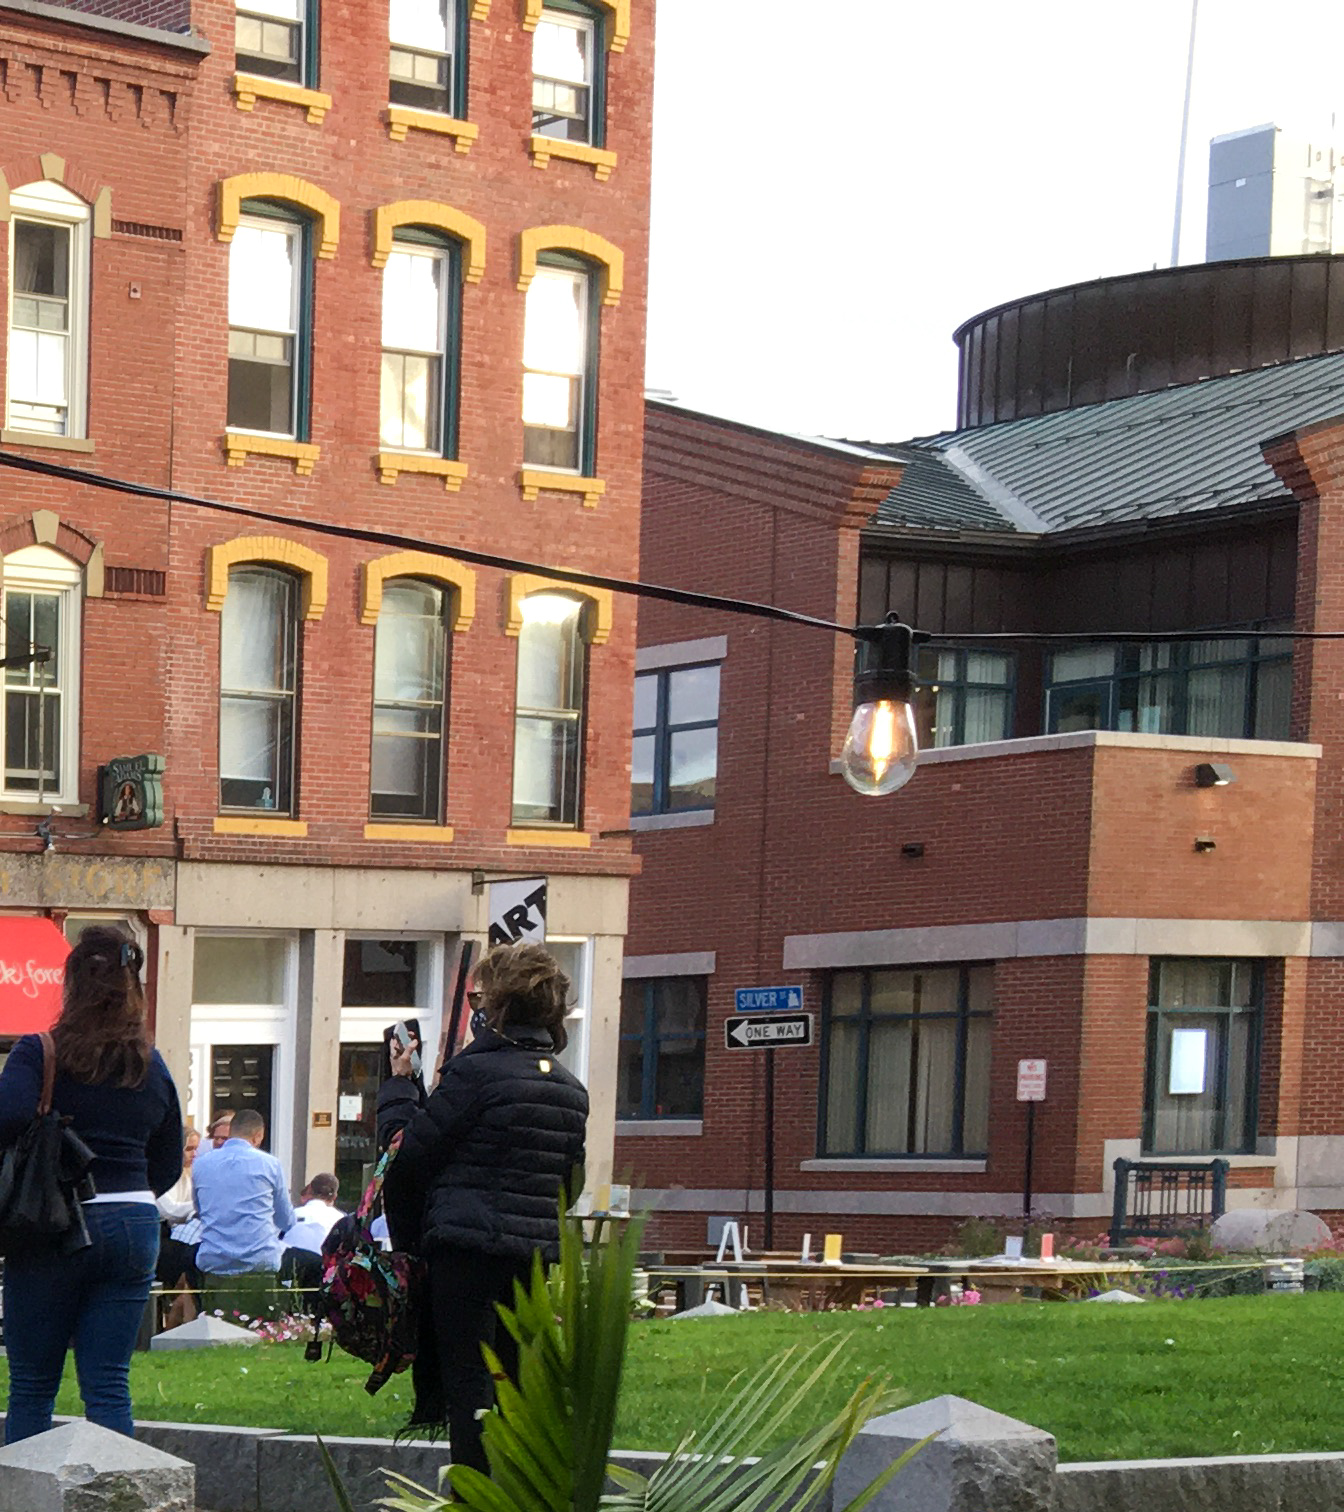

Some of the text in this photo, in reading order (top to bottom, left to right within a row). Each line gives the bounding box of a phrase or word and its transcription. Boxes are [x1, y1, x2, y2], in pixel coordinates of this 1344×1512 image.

[488, 884, 547, 946] ART
[739, 991, 777, 1008] SILVER
[745, 1024, 801, 1039] ONE WAY
